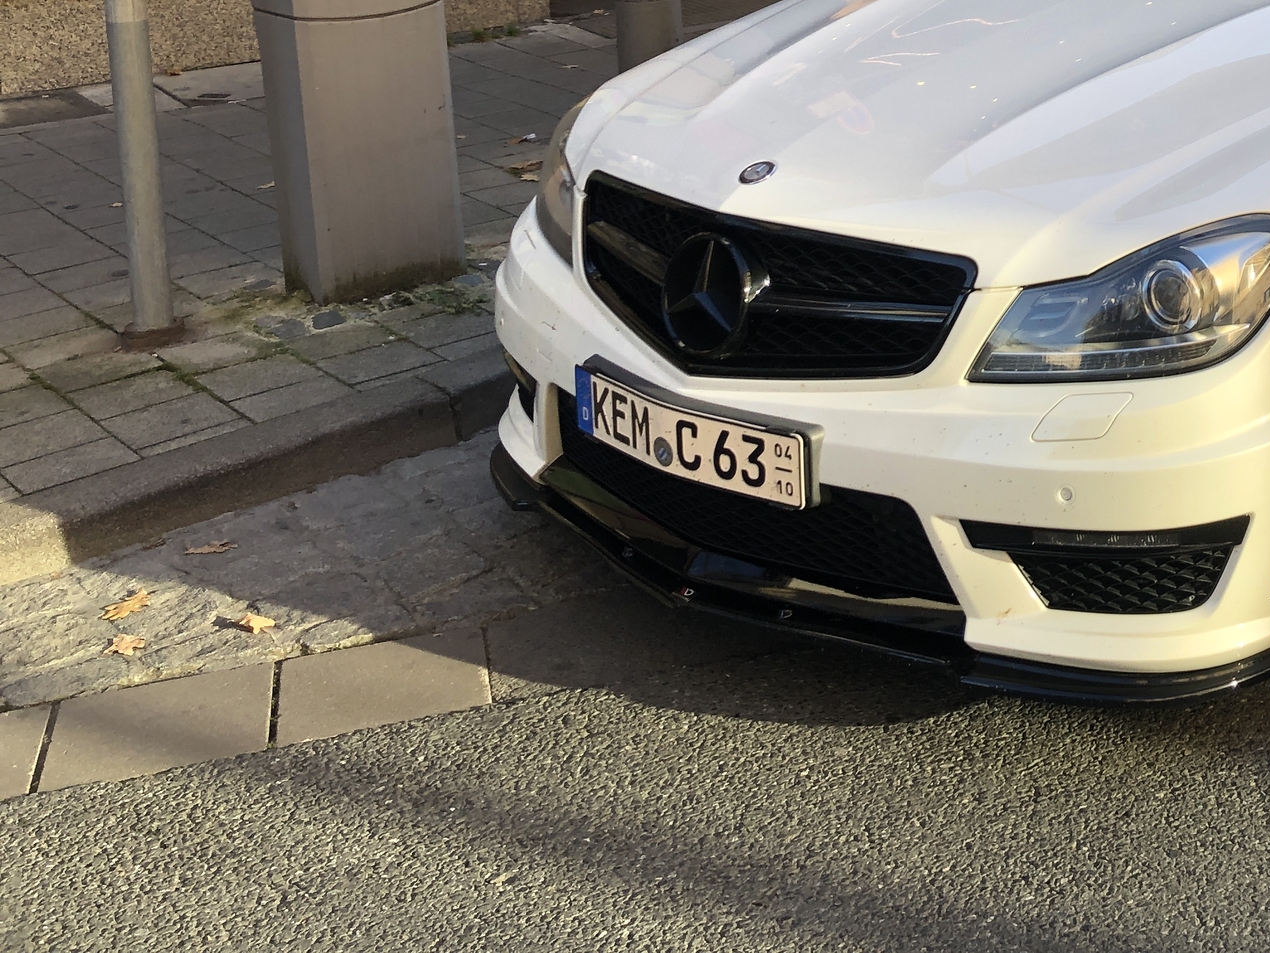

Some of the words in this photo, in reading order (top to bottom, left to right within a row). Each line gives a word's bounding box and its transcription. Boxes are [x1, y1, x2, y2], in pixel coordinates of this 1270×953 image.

[582, 406, 589, 421] D
[592, 381, 651, 457] KEM
[675, 419, 702, 471] C
[713, 430, 766, 488] 63
[774, 442, 793, 461] 04
[776, 480, 794, 497] 10
